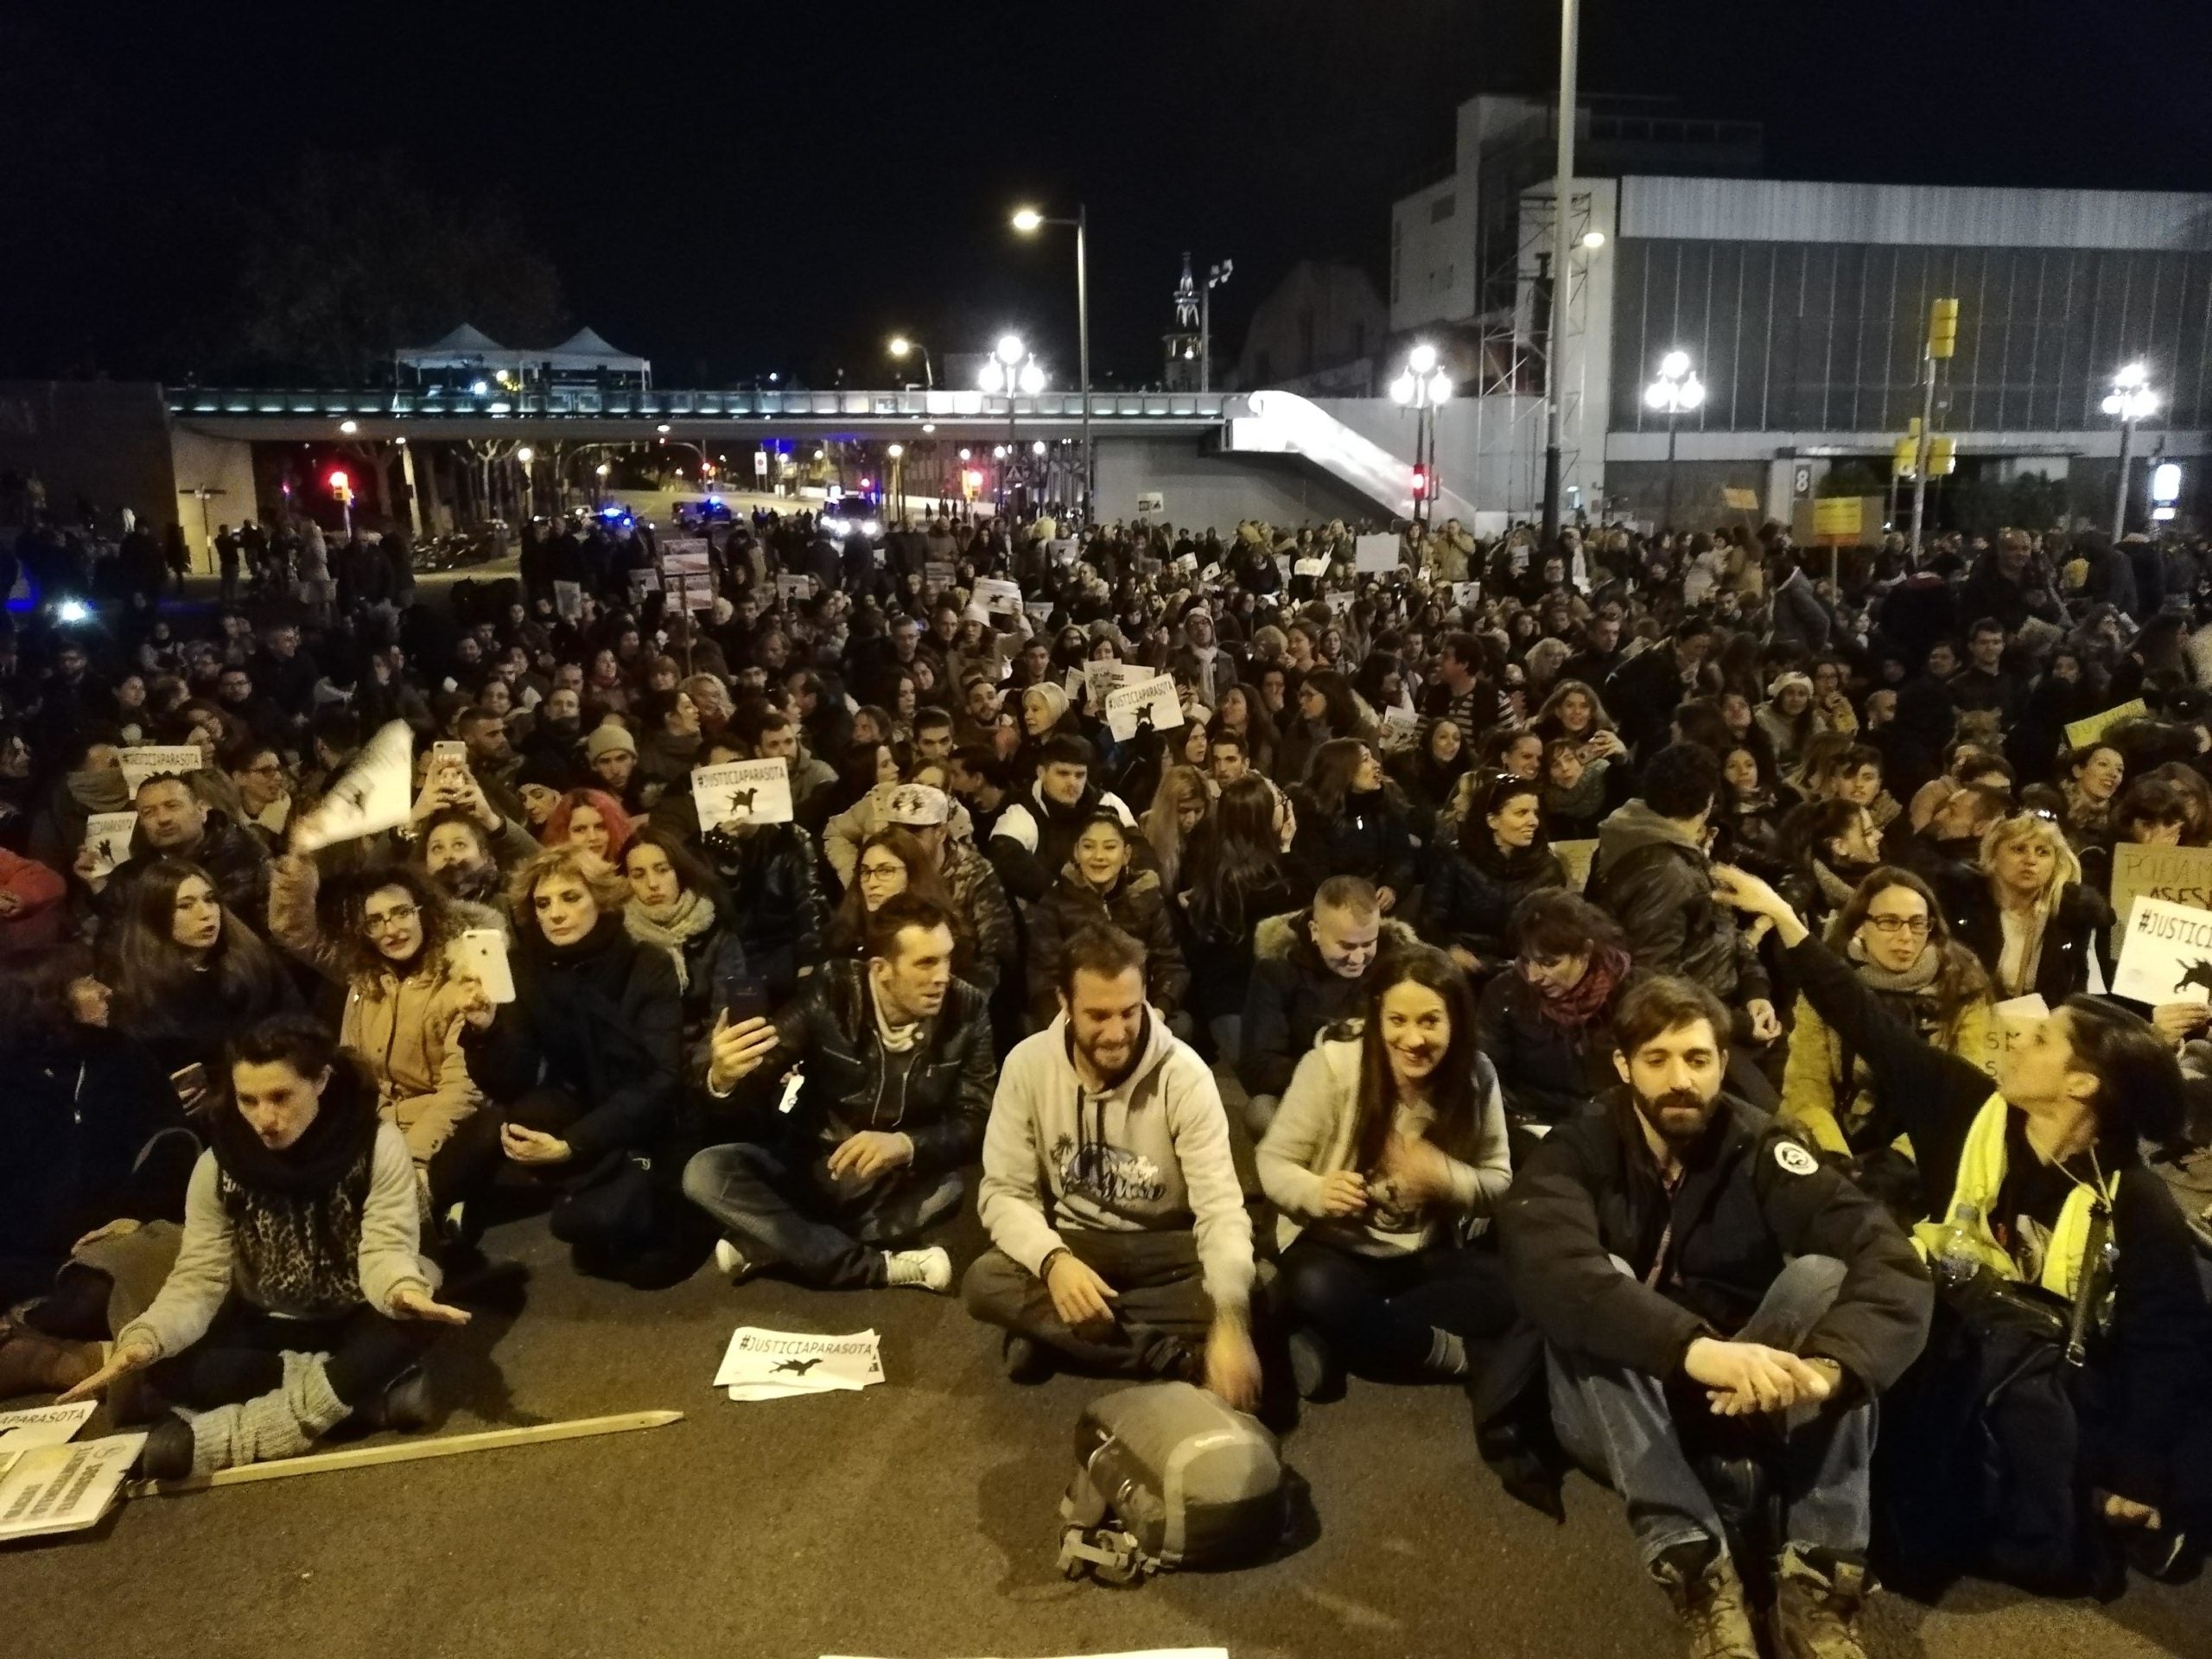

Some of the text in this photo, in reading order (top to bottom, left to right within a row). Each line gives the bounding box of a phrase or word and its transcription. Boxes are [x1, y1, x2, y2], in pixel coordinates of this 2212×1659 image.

[1796, 469, 1808, 492] 8
[1109, 680, 1174, 711] #JUSTICIAPARASOTA
[697, 766, 785, 788] #JUSTICIAPARASOTA
[739, 1334, 872, 1355] #JUSTICIAPARASOTA
